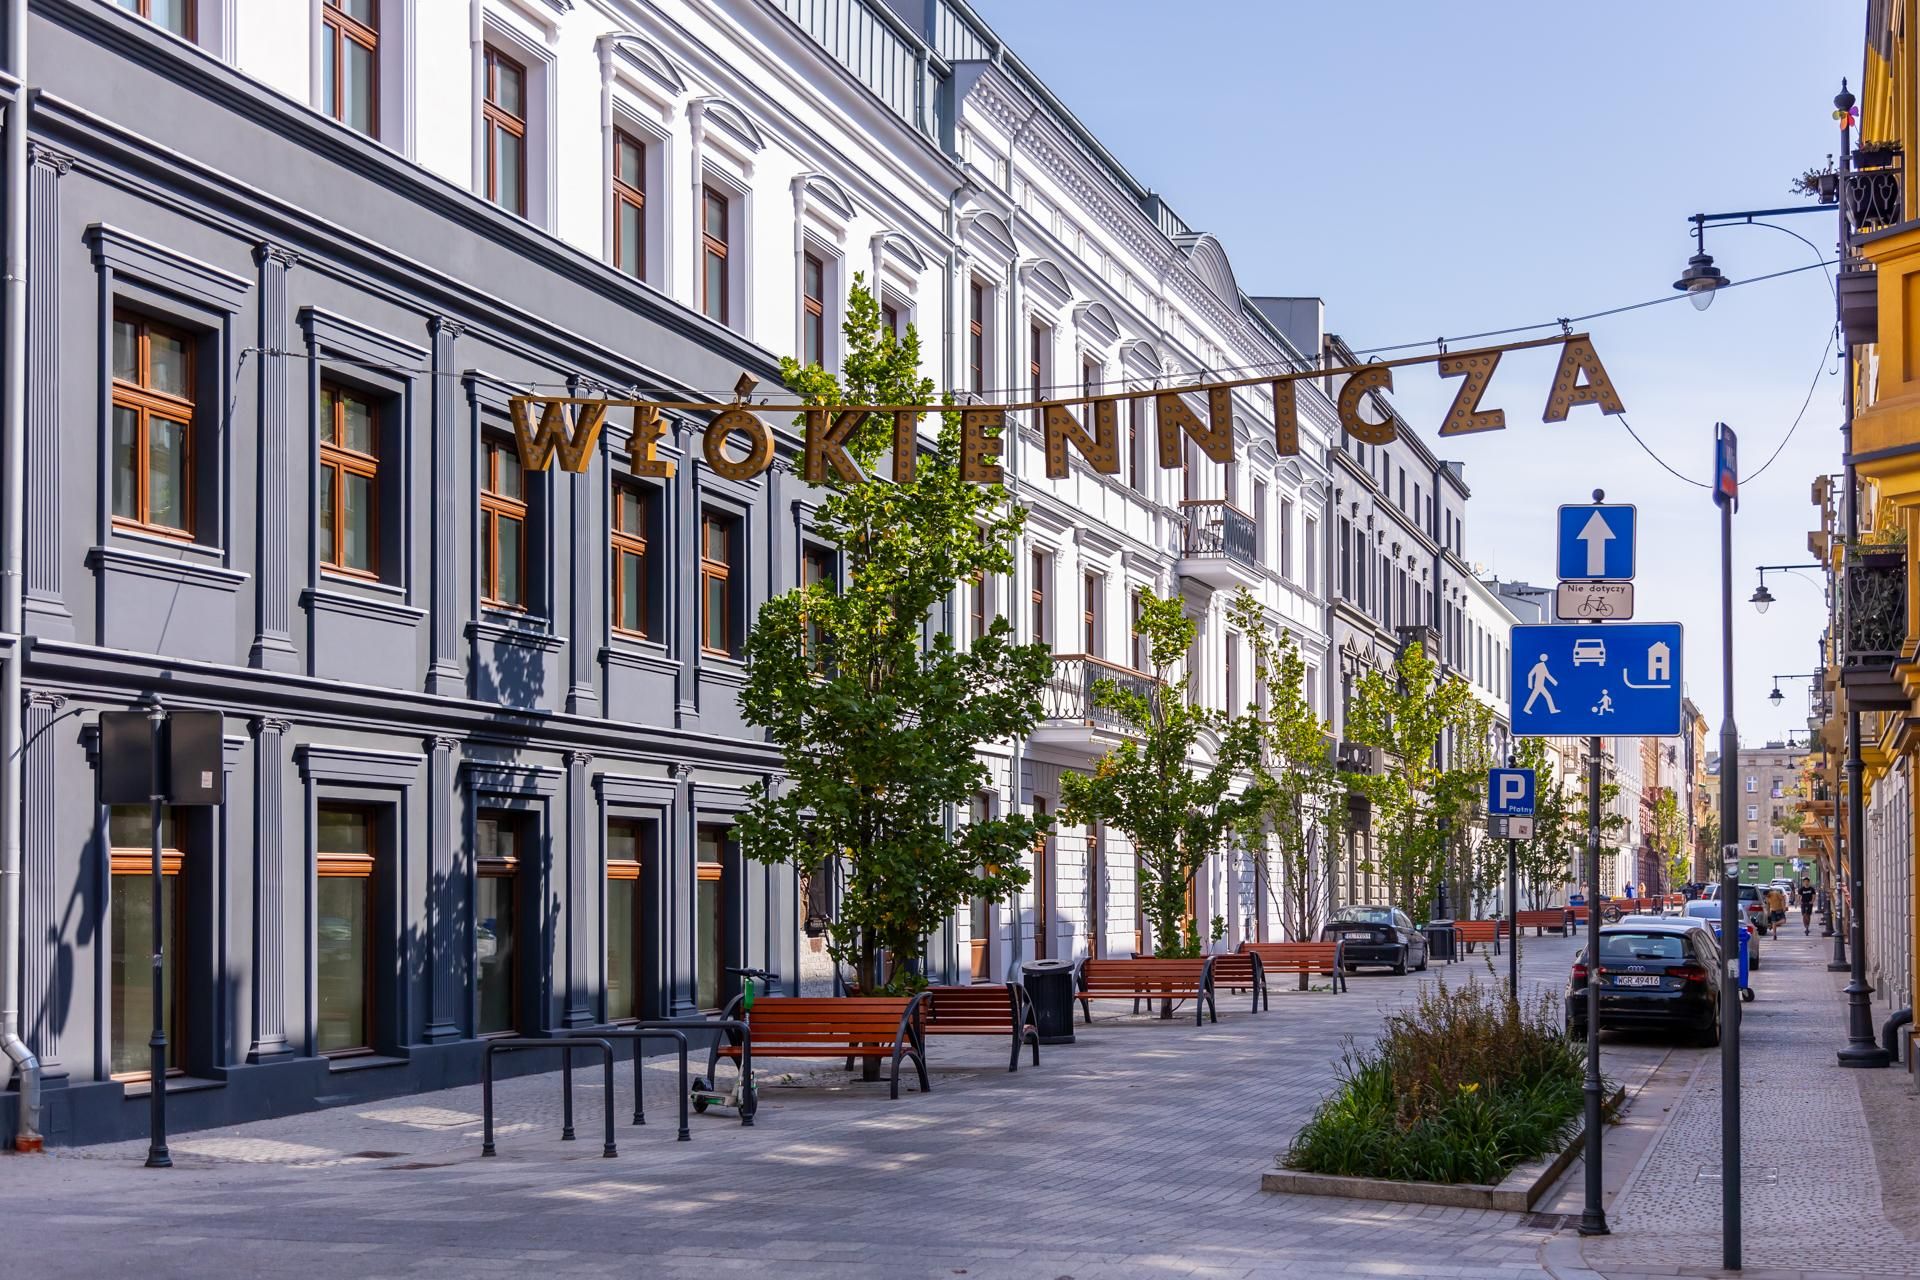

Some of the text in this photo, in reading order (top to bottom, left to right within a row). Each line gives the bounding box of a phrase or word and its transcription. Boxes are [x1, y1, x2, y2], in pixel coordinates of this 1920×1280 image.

[508, 333, 1627, 485] WŁÓKIENNICZA
[1568, 584, 1626, 594] Nie dotyczy
[1499, 773, 1526, 809] P
[1508, 805, 1533, 815] Płatny
[1617, 976, 1660, 985] WGR 49416
